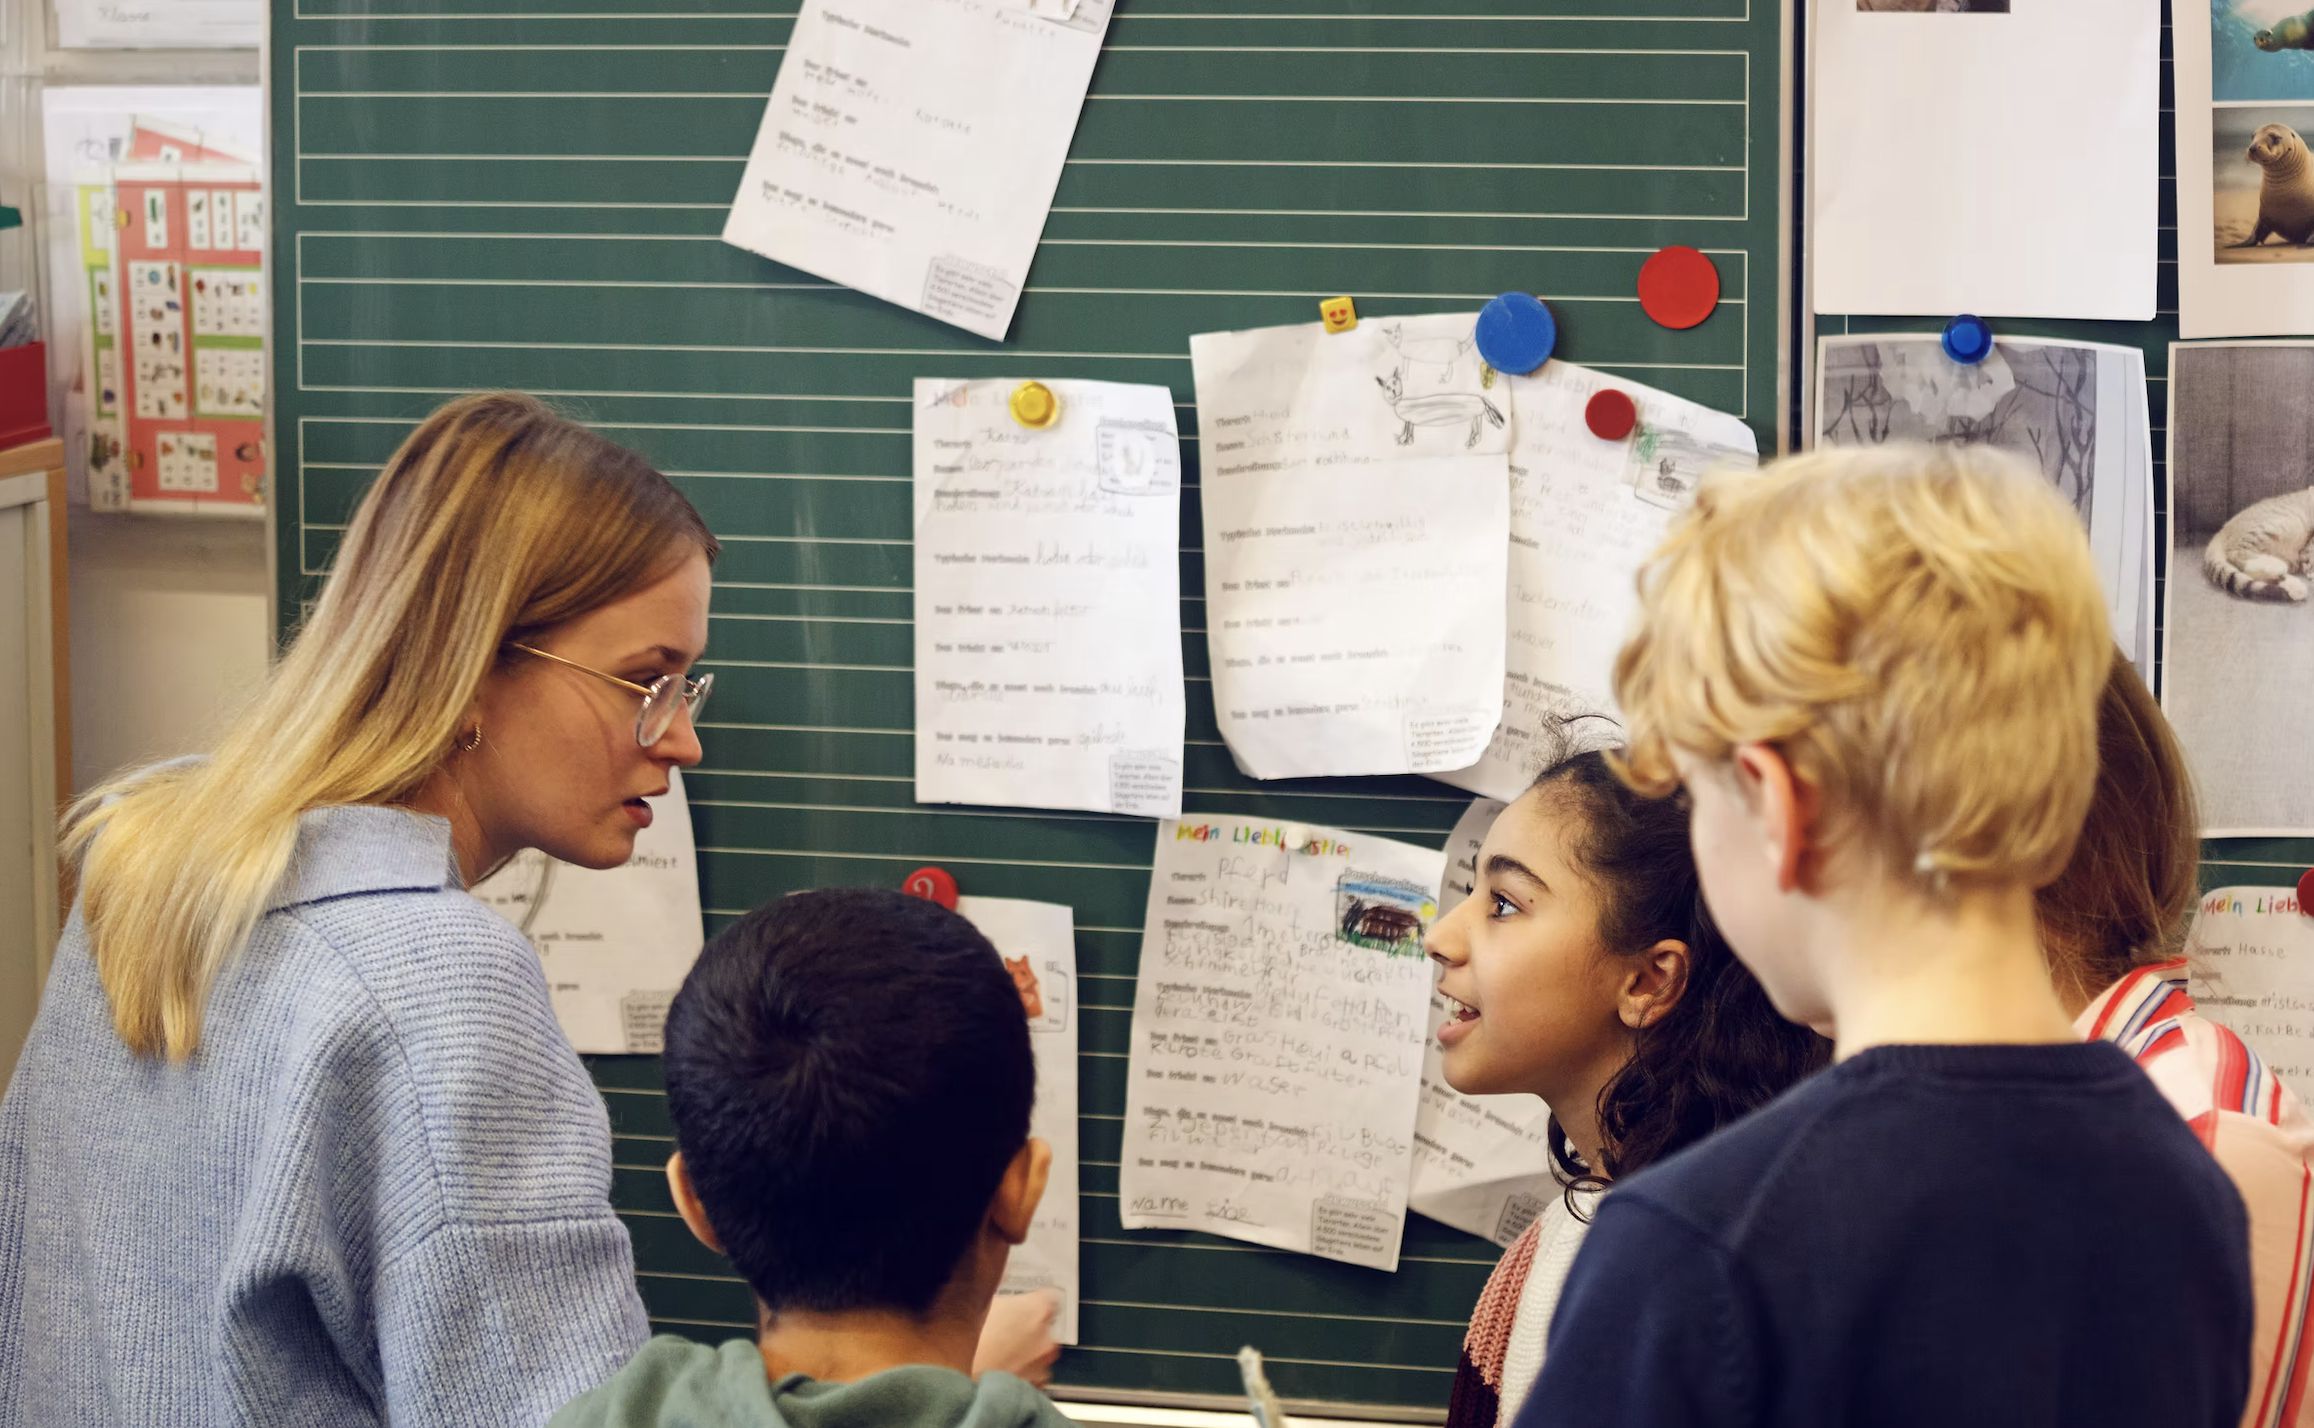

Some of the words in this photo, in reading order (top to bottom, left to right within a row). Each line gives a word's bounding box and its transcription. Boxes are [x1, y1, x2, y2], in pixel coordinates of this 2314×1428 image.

[1176, 823, 1220, 841] Mein
[2202, 893, 2243, 917] Mein
[2256, 895, 2306, 917] Lieb
